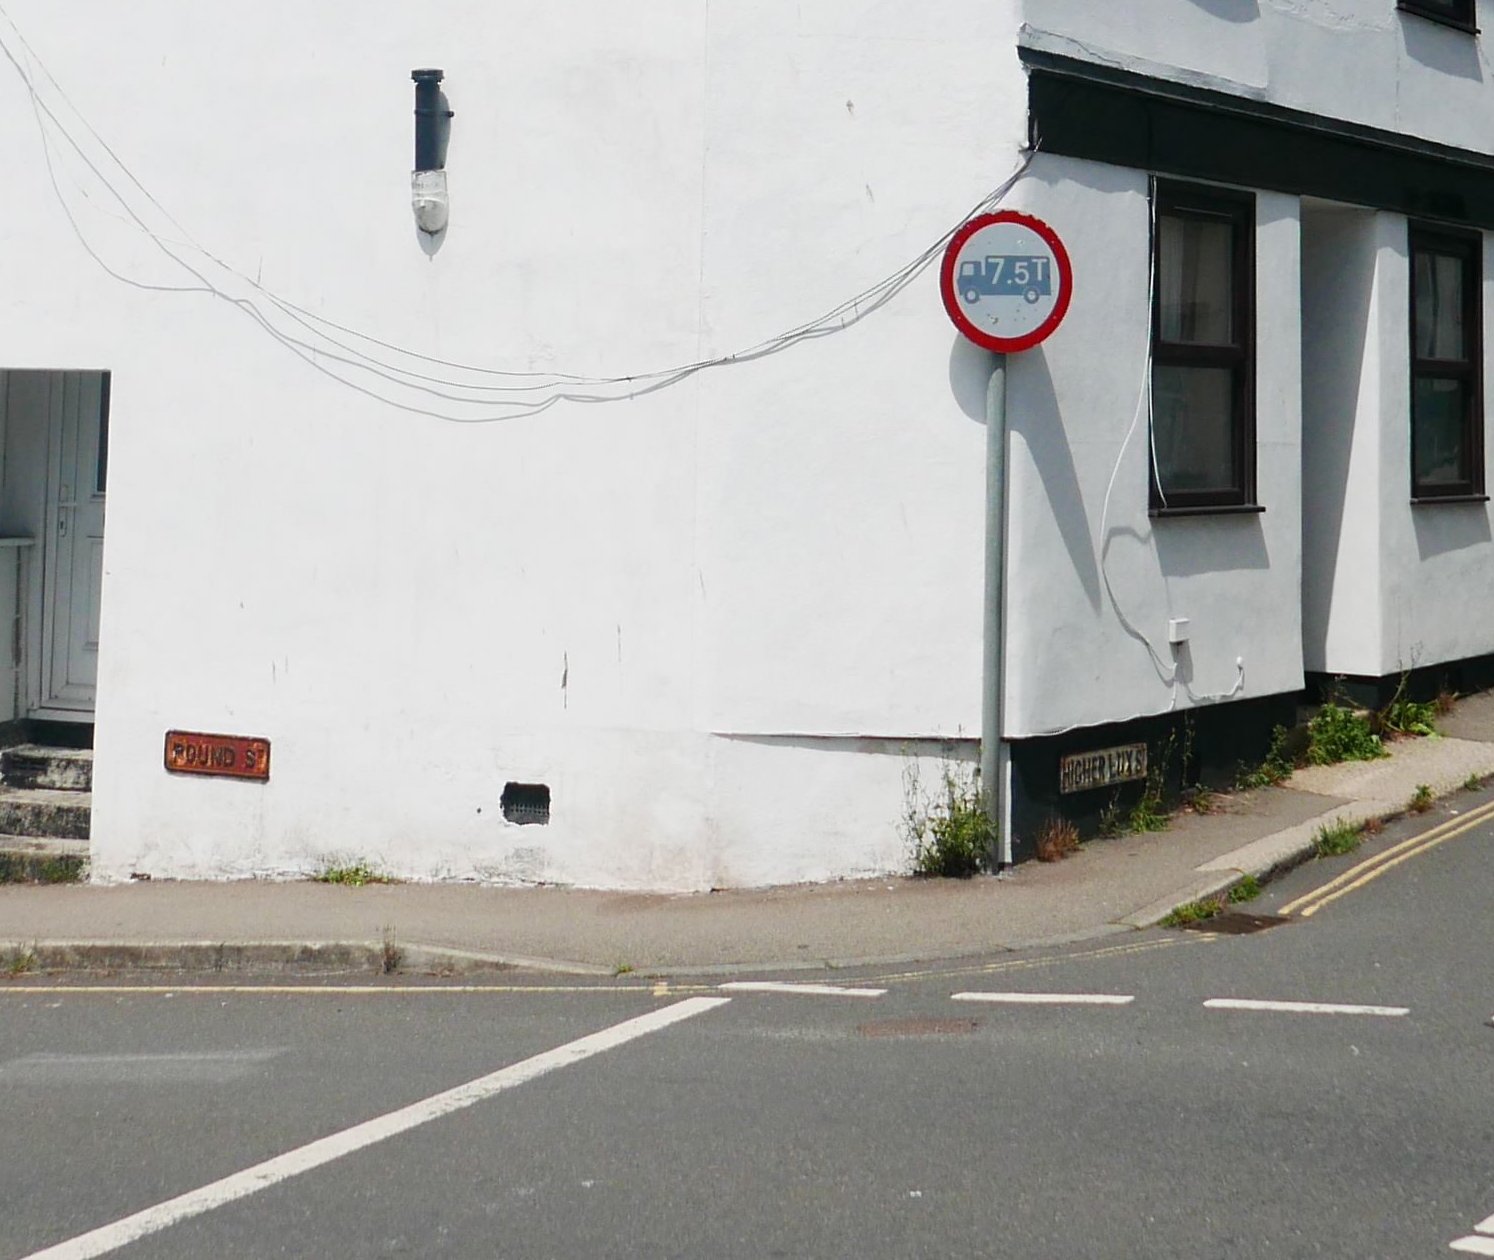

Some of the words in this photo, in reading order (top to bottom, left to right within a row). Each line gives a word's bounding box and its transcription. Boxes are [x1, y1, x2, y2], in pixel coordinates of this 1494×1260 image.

[987, 257, 1048, 285] 7.5T
[172, 742, 236, 768] POUND
[1061, 753, 1107, 791] HIGHER
[1108, 748, 1132, 779] LUX
